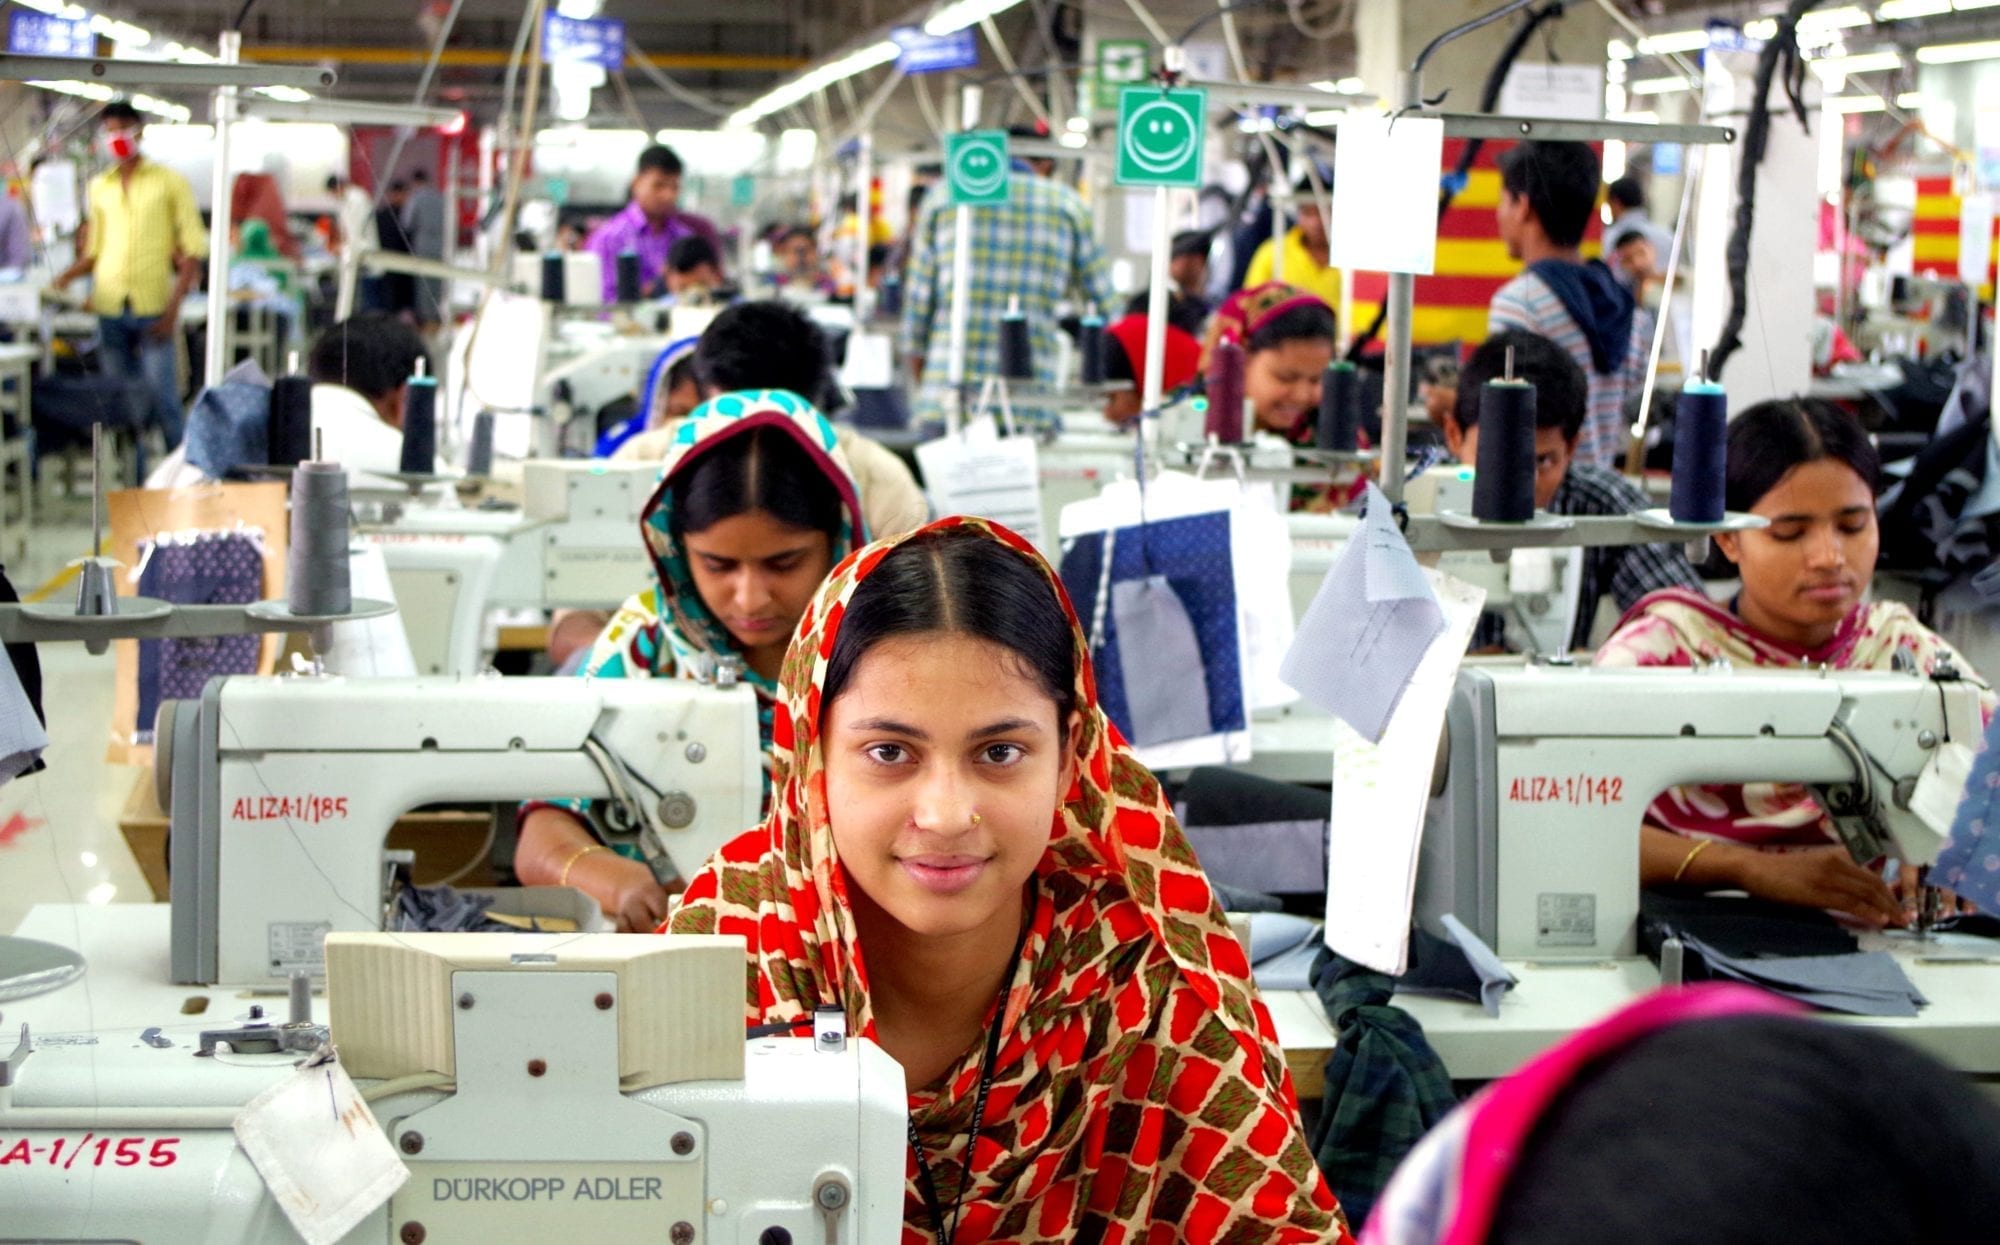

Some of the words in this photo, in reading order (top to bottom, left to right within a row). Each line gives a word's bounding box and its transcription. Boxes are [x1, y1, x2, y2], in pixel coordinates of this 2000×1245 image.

[0, 1131, 181, 1169] A-1/155
[433, 1177, 565, 1200] DÜRKOPP
[574, 1177, 662, 1200] ADLER
